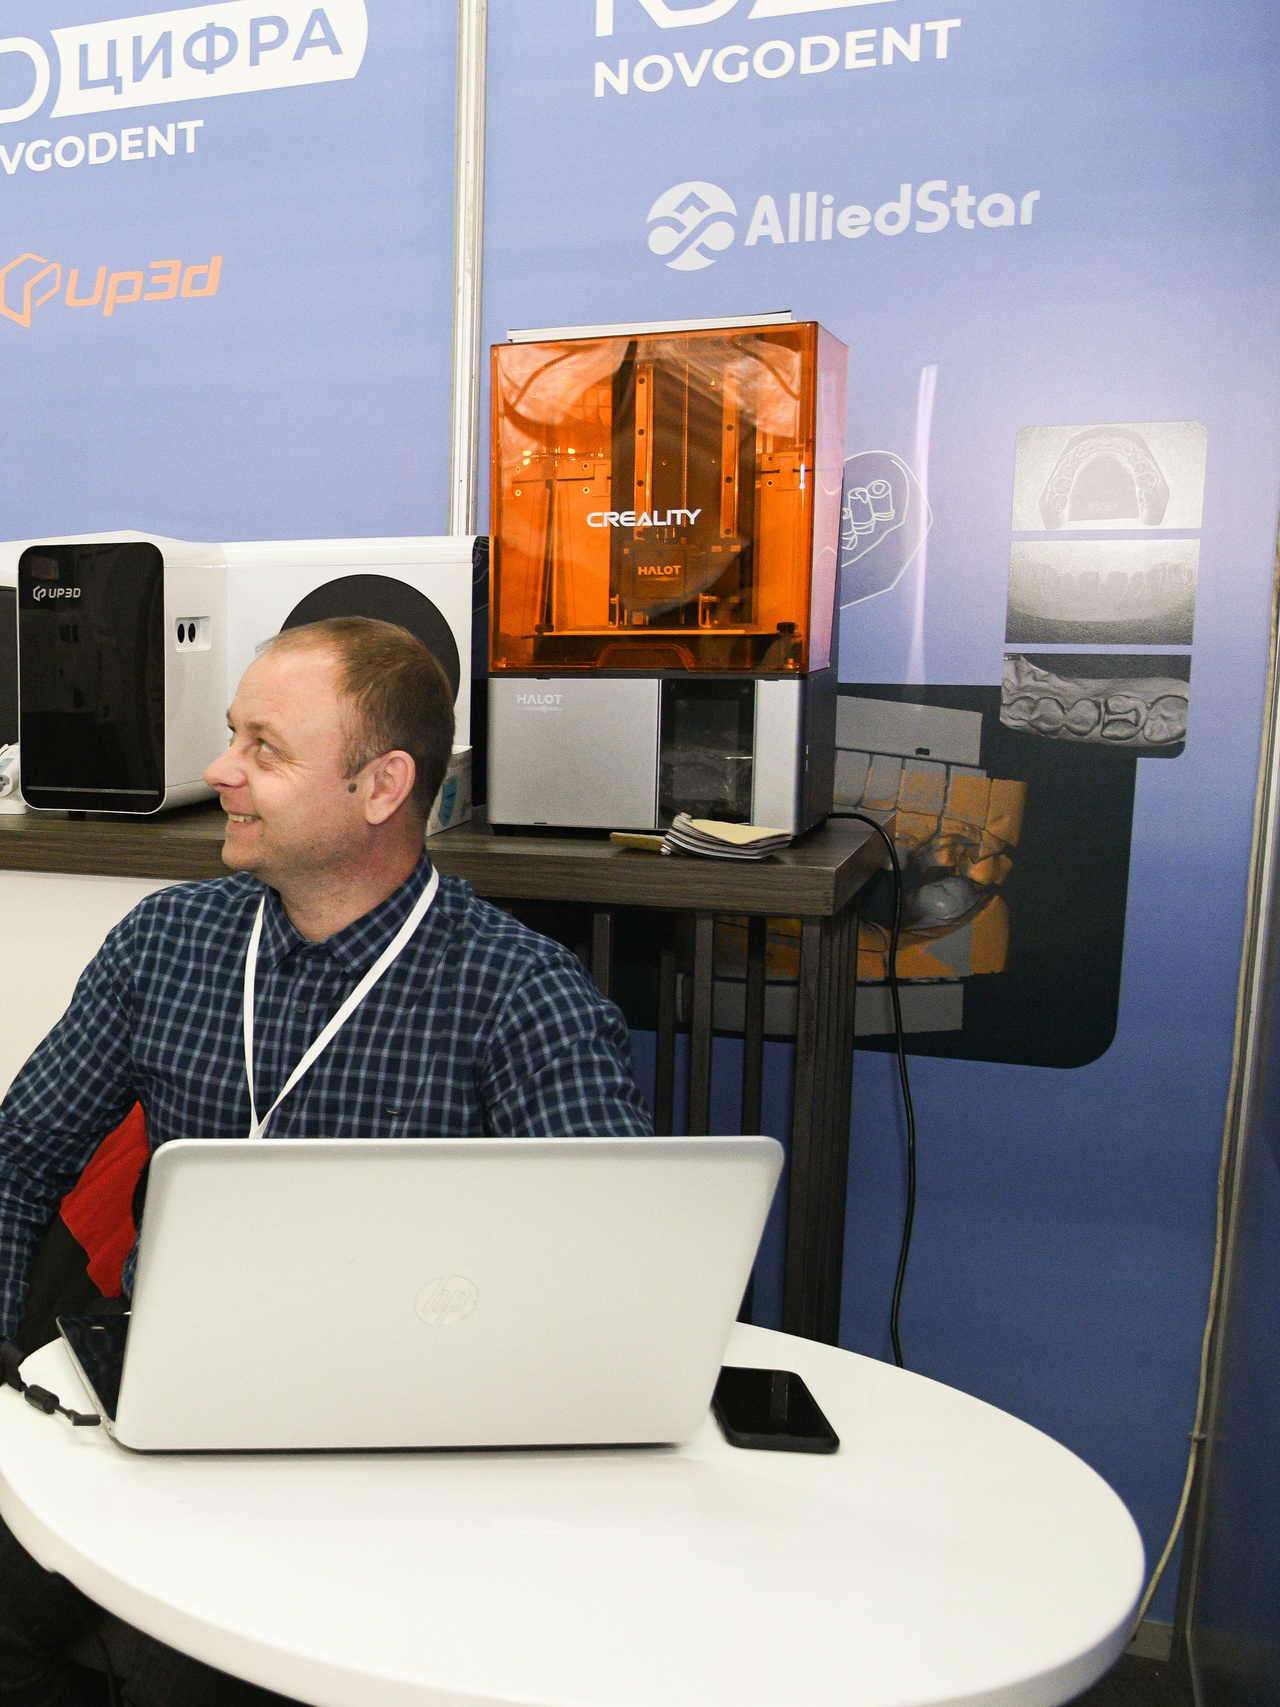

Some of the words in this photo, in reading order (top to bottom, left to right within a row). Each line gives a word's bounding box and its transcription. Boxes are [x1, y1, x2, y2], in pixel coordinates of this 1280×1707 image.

[78, 8, 344, 96] ЦИФРА
[594, 18, 963, 98] NOVGODENT
[743, 179, 1041, 247] AlliedStar
[586, 508, 703, 528] CREALITY
[637, 565, 682, 576] HALOT
[48, 587, 81, 599] UP3D
[516, 693, 563, 705] HALOT
